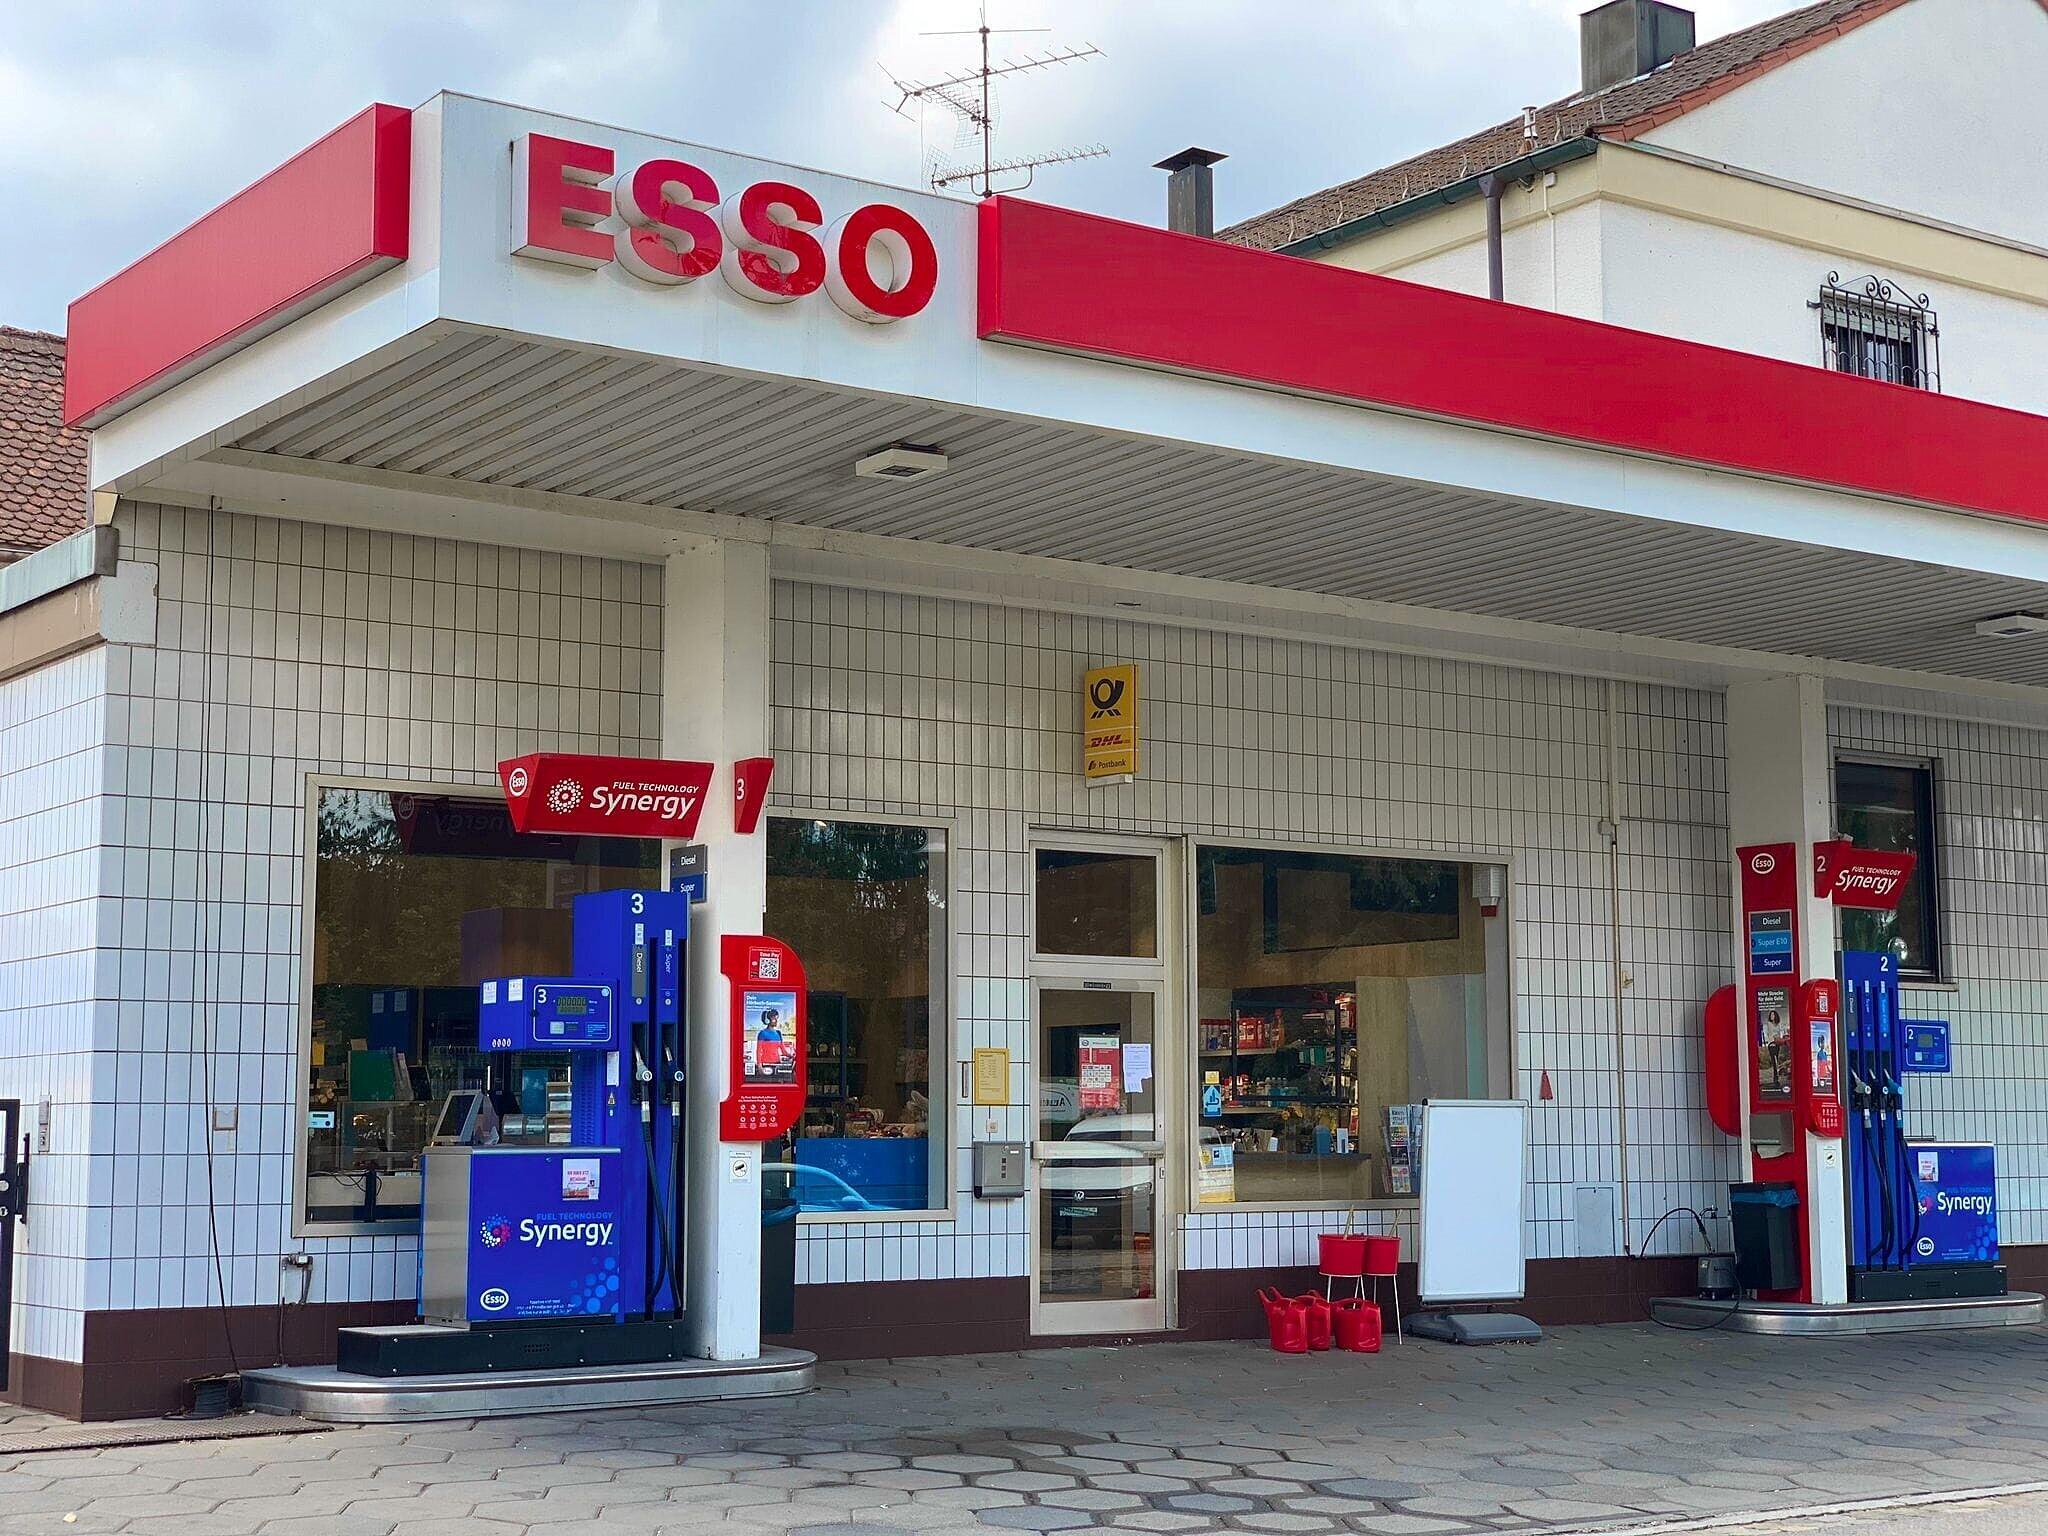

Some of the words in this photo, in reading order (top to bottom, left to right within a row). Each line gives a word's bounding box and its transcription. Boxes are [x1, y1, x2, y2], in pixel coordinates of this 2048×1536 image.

[525, 132, 939, 319] ESSO
[1091, 734, 1123, 748] DHL
[1098, 758, 1127, 769] Postbank
[511, 775, 525, 789] Esso
[613, 781, 635, 791] FUEL
[638, 783, 699, 794] TECHNOLOGY
[736, 778, 745, 800] 3
[590, 787, 696, 820] Synergy
[680, 854, 697, 866] Diesel
[1754, 858, 1772, 869] Esso
[1816, 855, 1826, 872] 2
[1866, 867, 1902, 876] TECHNOLOGY
[680, 883, 696, 894] Super
[1835, 869, 1898, 895] Synergy
[631, 893, 645, 915] 3
[1762, 916, 1782, 926] Diesel
[1757, 938, 1775, 948] Super
[1776, 937, 1788, 946] E10
[665, 953, 673, 974] Super
[1763, 957, 1783, 968] Super
[1880, 956, 1889, 972] 2
[537, 988, 547, 1004] 3
[1908, 1028, 1914, 1040] 2
[1937, 1192, 1993, 1217] Synergy
[536, 1213, 557, 1221] FUEL
[559, 1211, 613, 1221] TECHNOLOGY
[519, 1218, 613, 1248] Synergy
[484, 1293, 505, 1304] Esso
